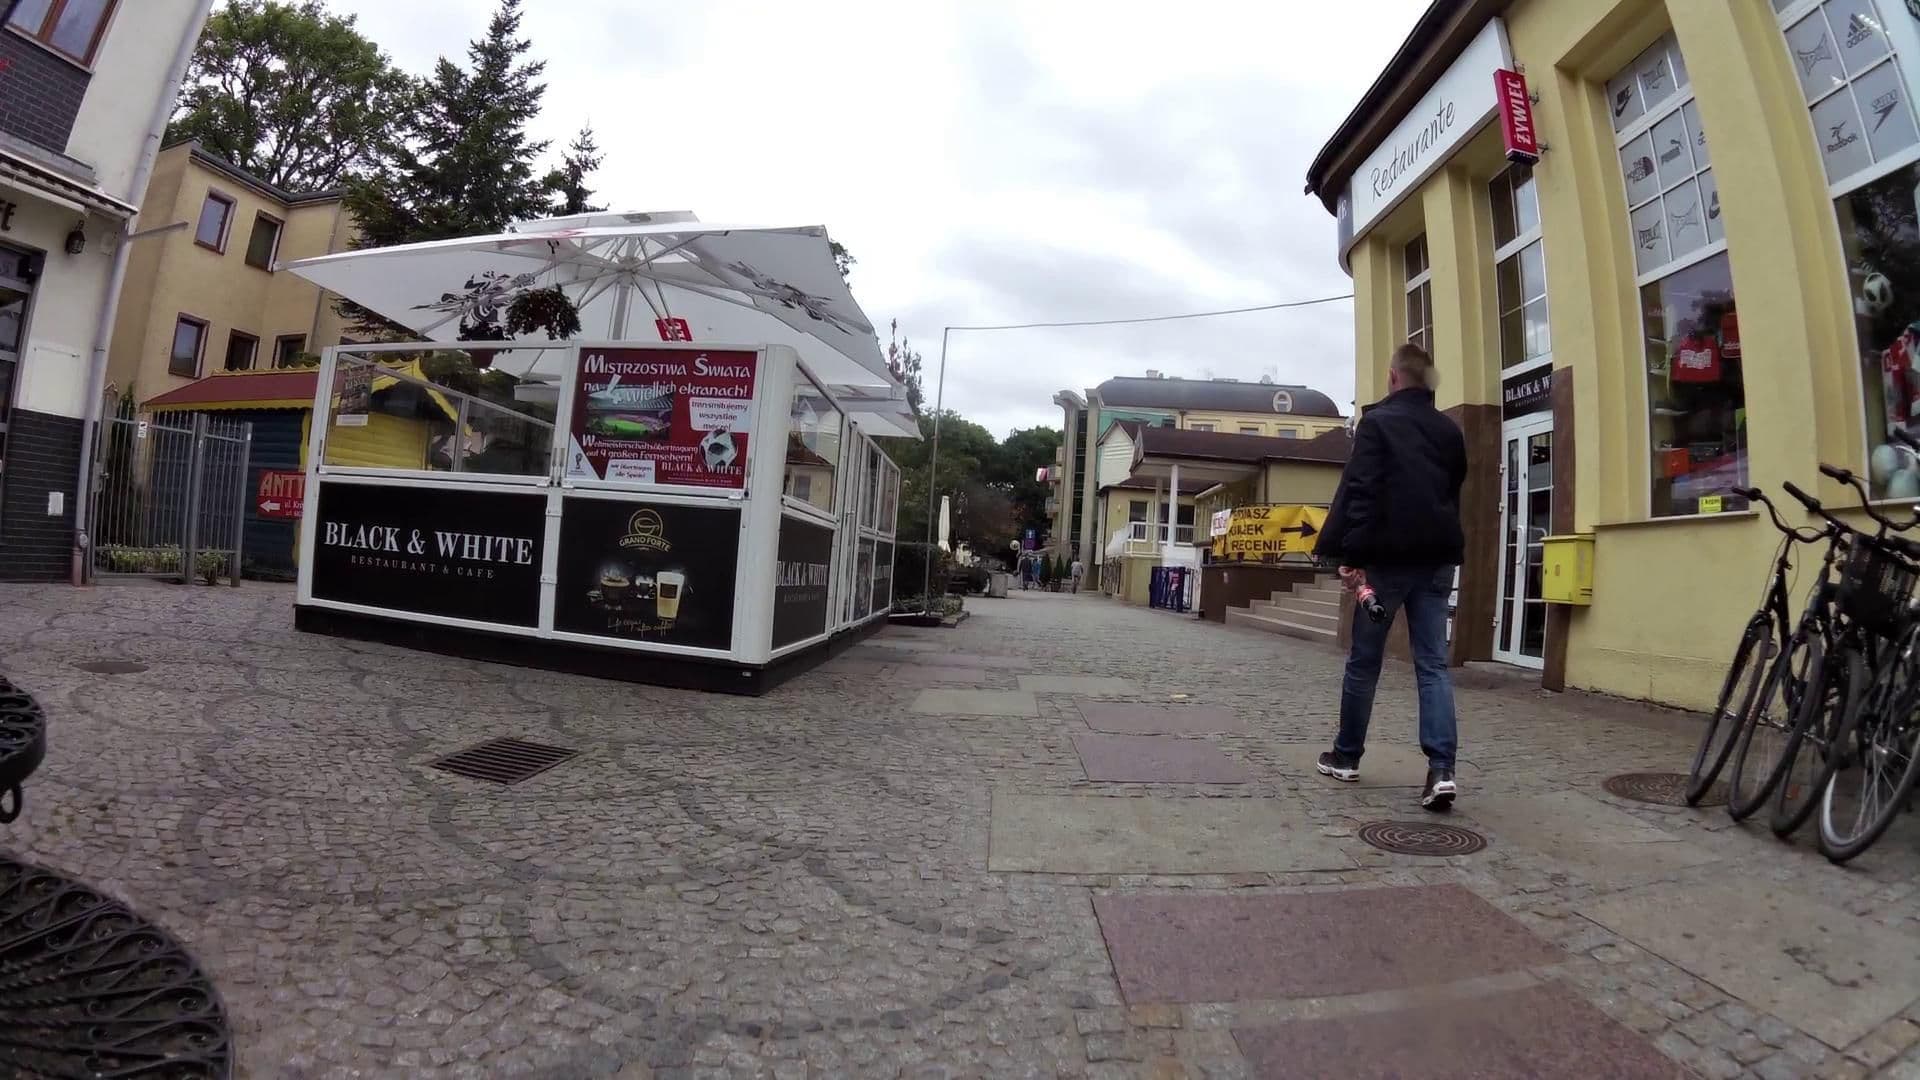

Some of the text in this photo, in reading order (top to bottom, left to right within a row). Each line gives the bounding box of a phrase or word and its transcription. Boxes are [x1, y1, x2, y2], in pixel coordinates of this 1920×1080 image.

[1506, 77, 1532, 146] ŻYWIEC
[1370, 96, 1456, 203] Restaurante
[584, 353, 751, 378] MISTRZOSTWA ŚWIATA
[583, 381, 600, 392] na
[625, 380, 677, 403] wielkich
[679, 382, 748, 397] ekranach!
[1505, 382, 1532, 403] BLACK
[1533, 379, 1540, 394] &
[661, 461, 694, 473] BLACK
[706, 464, 743, 475] WHITE
[324, 521, 533, 566] BLACK & WHITE
[618, 535, 672, 552] GRANO FORTE
[351, 554, 495, 579] RESTAURANT & CAFE
